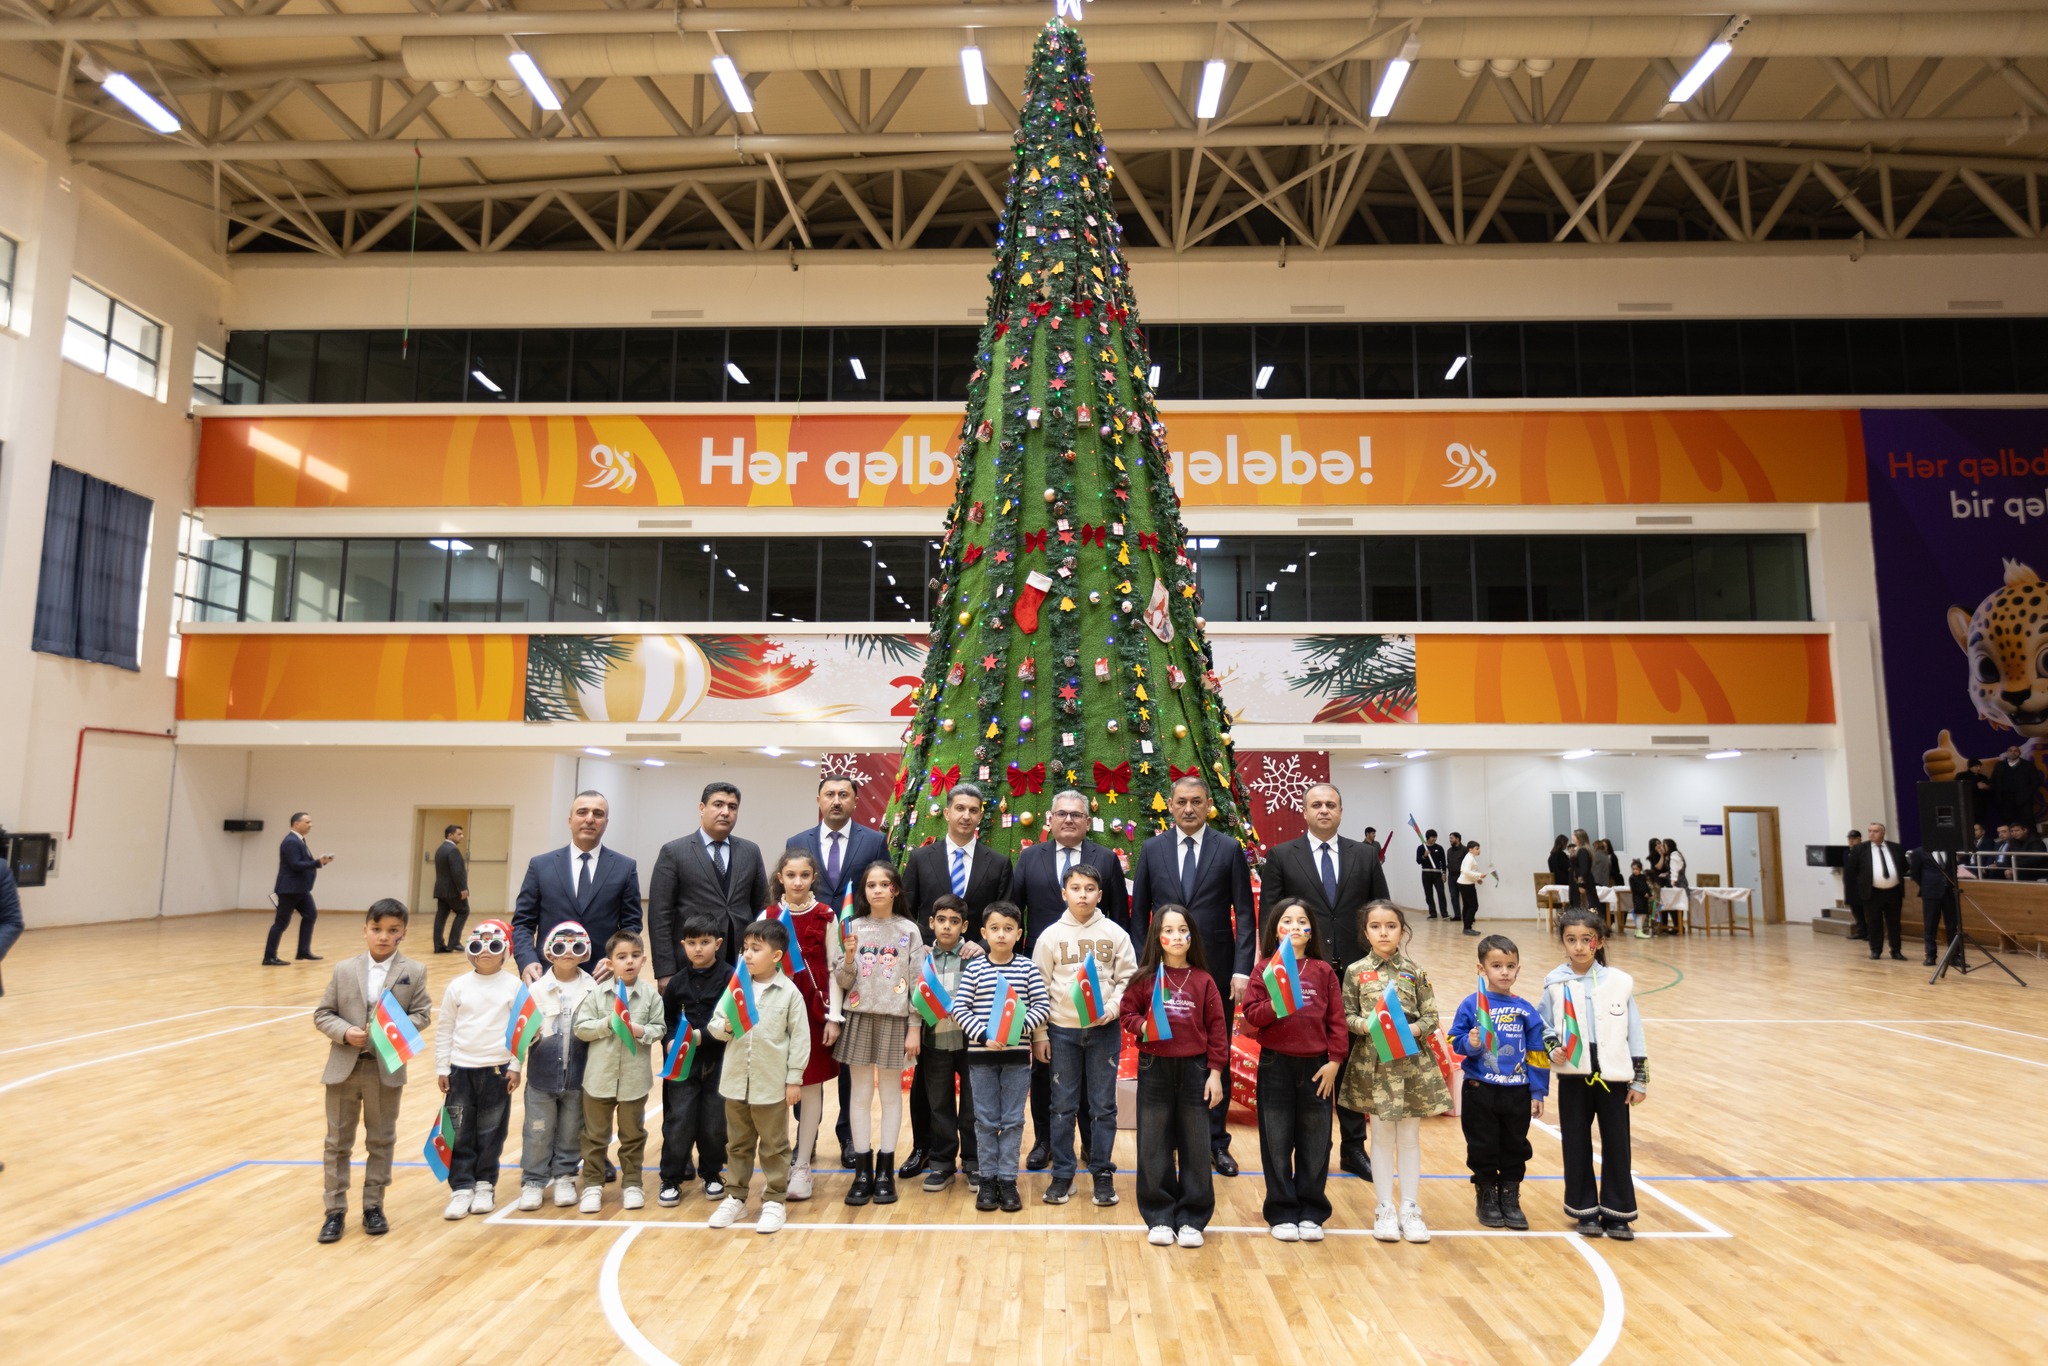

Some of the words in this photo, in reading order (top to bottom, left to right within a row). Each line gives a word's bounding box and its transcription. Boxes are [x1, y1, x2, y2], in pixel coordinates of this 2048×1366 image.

[701, 437, 808, 486] Hər
[825, 435, 960, 499] qəlb
[1888, 451, 1949, 479] Hər
[1950, 490, 1995, 519] bir
